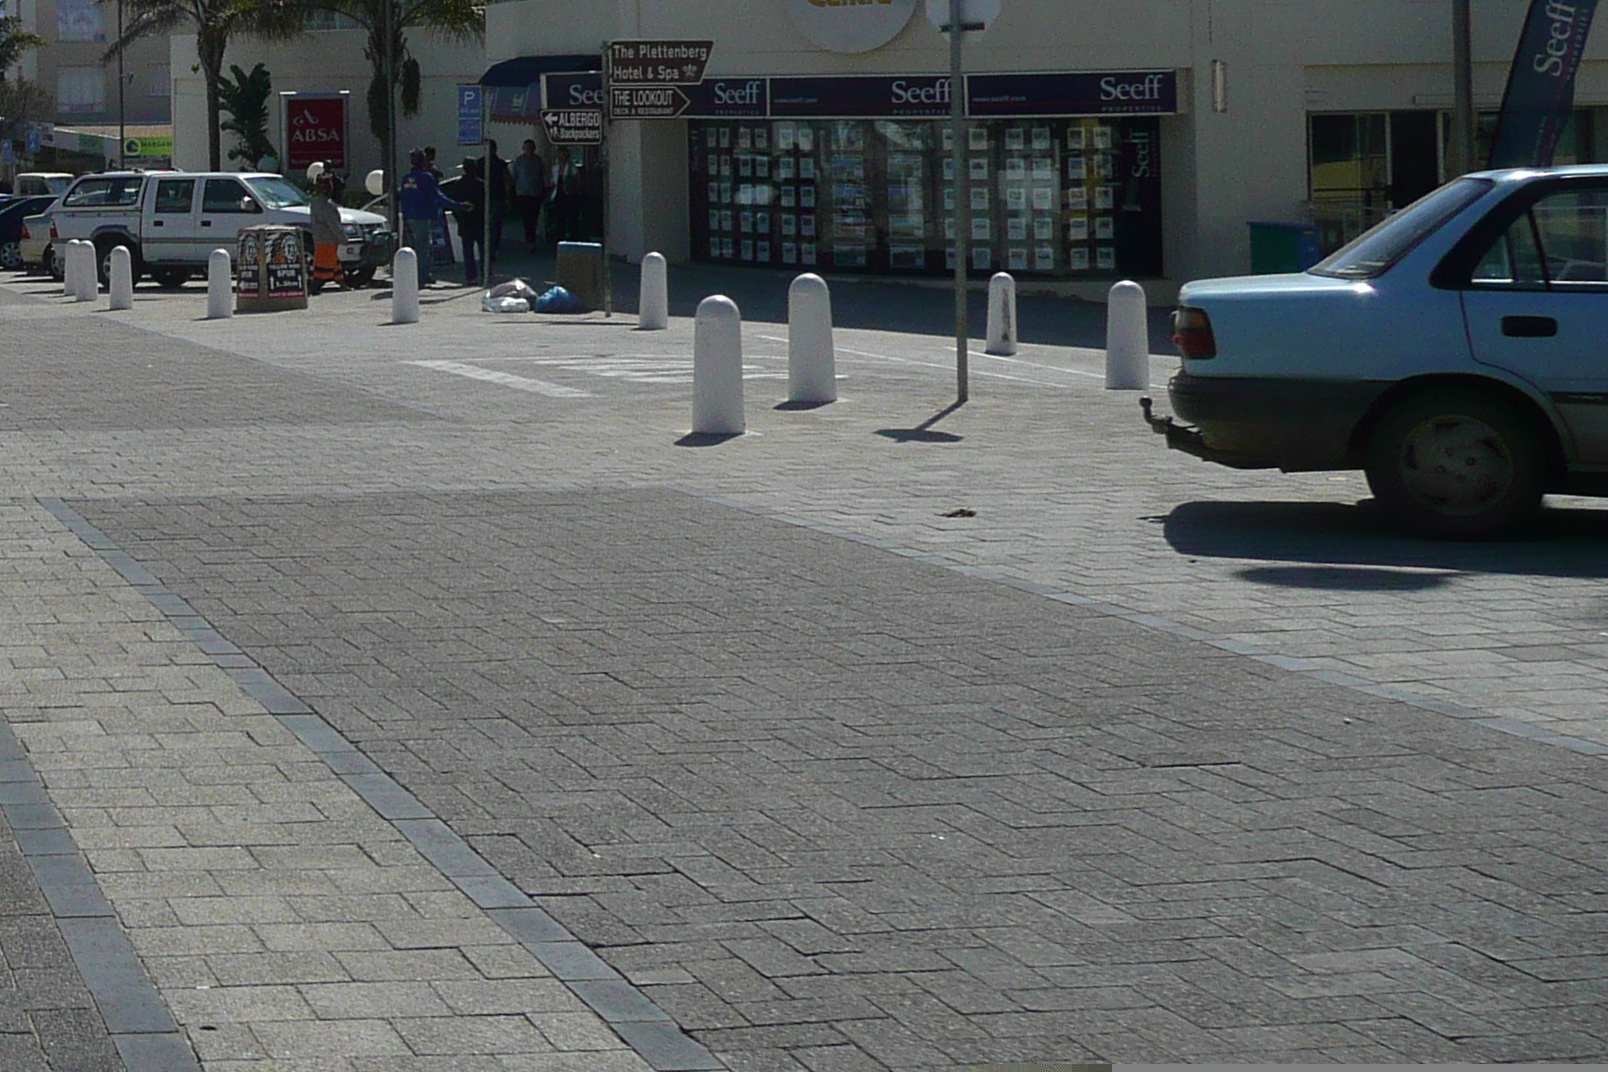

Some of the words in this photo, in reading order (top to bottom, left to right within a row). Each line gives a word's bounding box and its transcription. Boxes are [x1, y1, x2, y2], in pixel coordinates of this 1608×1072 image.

[613, 45, 635, 59] The
[639, 44, 707, 61] Plettenberg
[613, 65, 644, 80] Hotel
[647, 66, 654, 79] &
[657, 65, 679, 81] Spa
[714, 81, 760, 105] Seeff
[891, 78, 953, 104] Seeff
[1100, 75, 1164, 101] Seeff
[614, 91, 631, 106] THE
[633, 91, 674, 106] LOOKOUT
[559, 113, 600, 126] ALBERGO
[292, 128, 340, 142] ABSA
[560, 128, 600, 140] Backpackers
